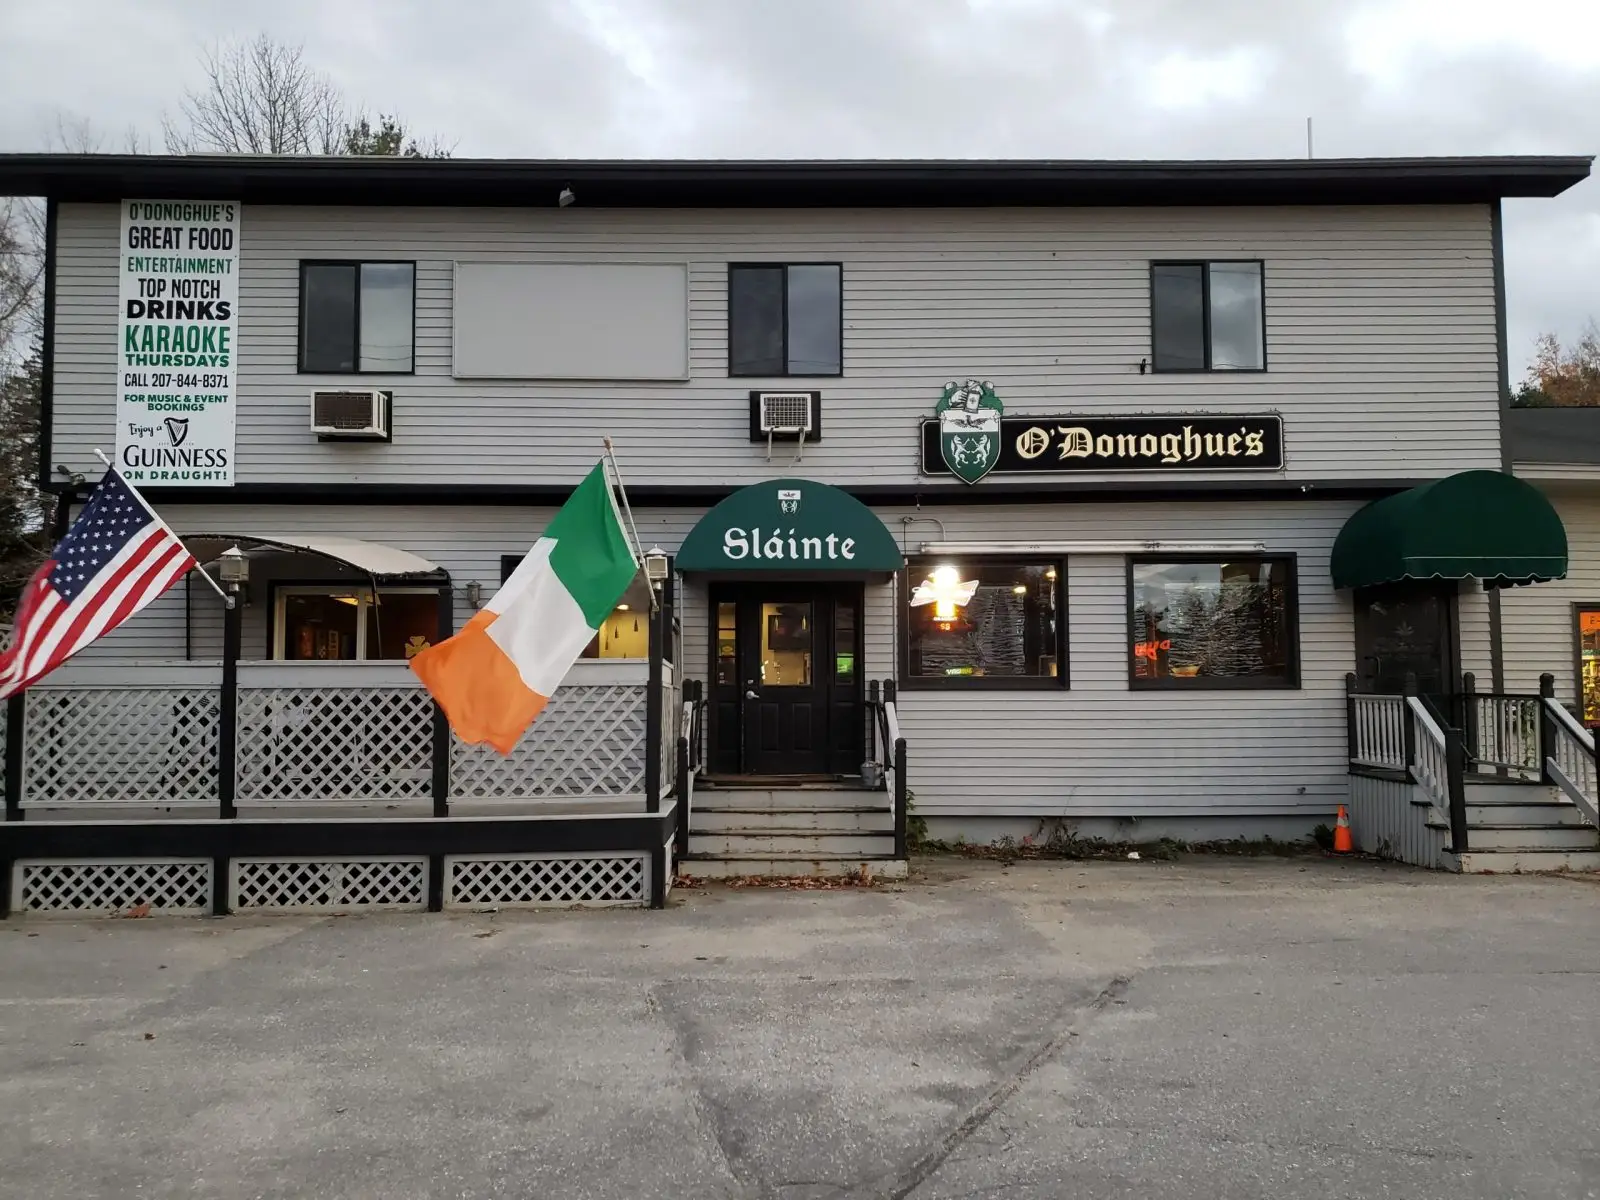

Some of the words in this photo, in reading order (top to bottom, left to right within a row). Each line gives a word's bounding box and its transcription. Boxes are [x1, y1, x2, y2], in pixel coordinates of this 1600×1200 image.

[129, 202, 234, 222] O'DONOGHUE'S
[128, 225, 183, 249] GREAT
[188, 227, 233, 250] FOOD
[127, 256, 233, 274] ENTERTAINMENT
[138, 278, 166, 298] TOP
[171, 279, 220, 299] NOTCH
[126, 299, 231, 320] DRINKS
[125, 324, 231, 353] KARAOKE
[125, 353, 230, 368] THURSDAYS
[124, 373, 149, 387] CALL
[151, 373, 229, 389] 207-844-8371
[124, 394, 146, 403] FOR
[147, 394, 181, 403] MUSIC
[183, 394, 192, 403] &
[194, 395, 229, 403] EVENT
[147, 402, 205, 412] BOOKINGS
[128, 422, 154, 438] Enjoy
[1015, 425, 1265, 463] O'Donoghue's
[123, 444, 228, 468] GUINNESS
[123, 470, 144, 480] ON
[150, 471, 228, 480] DRAUGHT!
[723, 527, 856, 560] Sláinte
